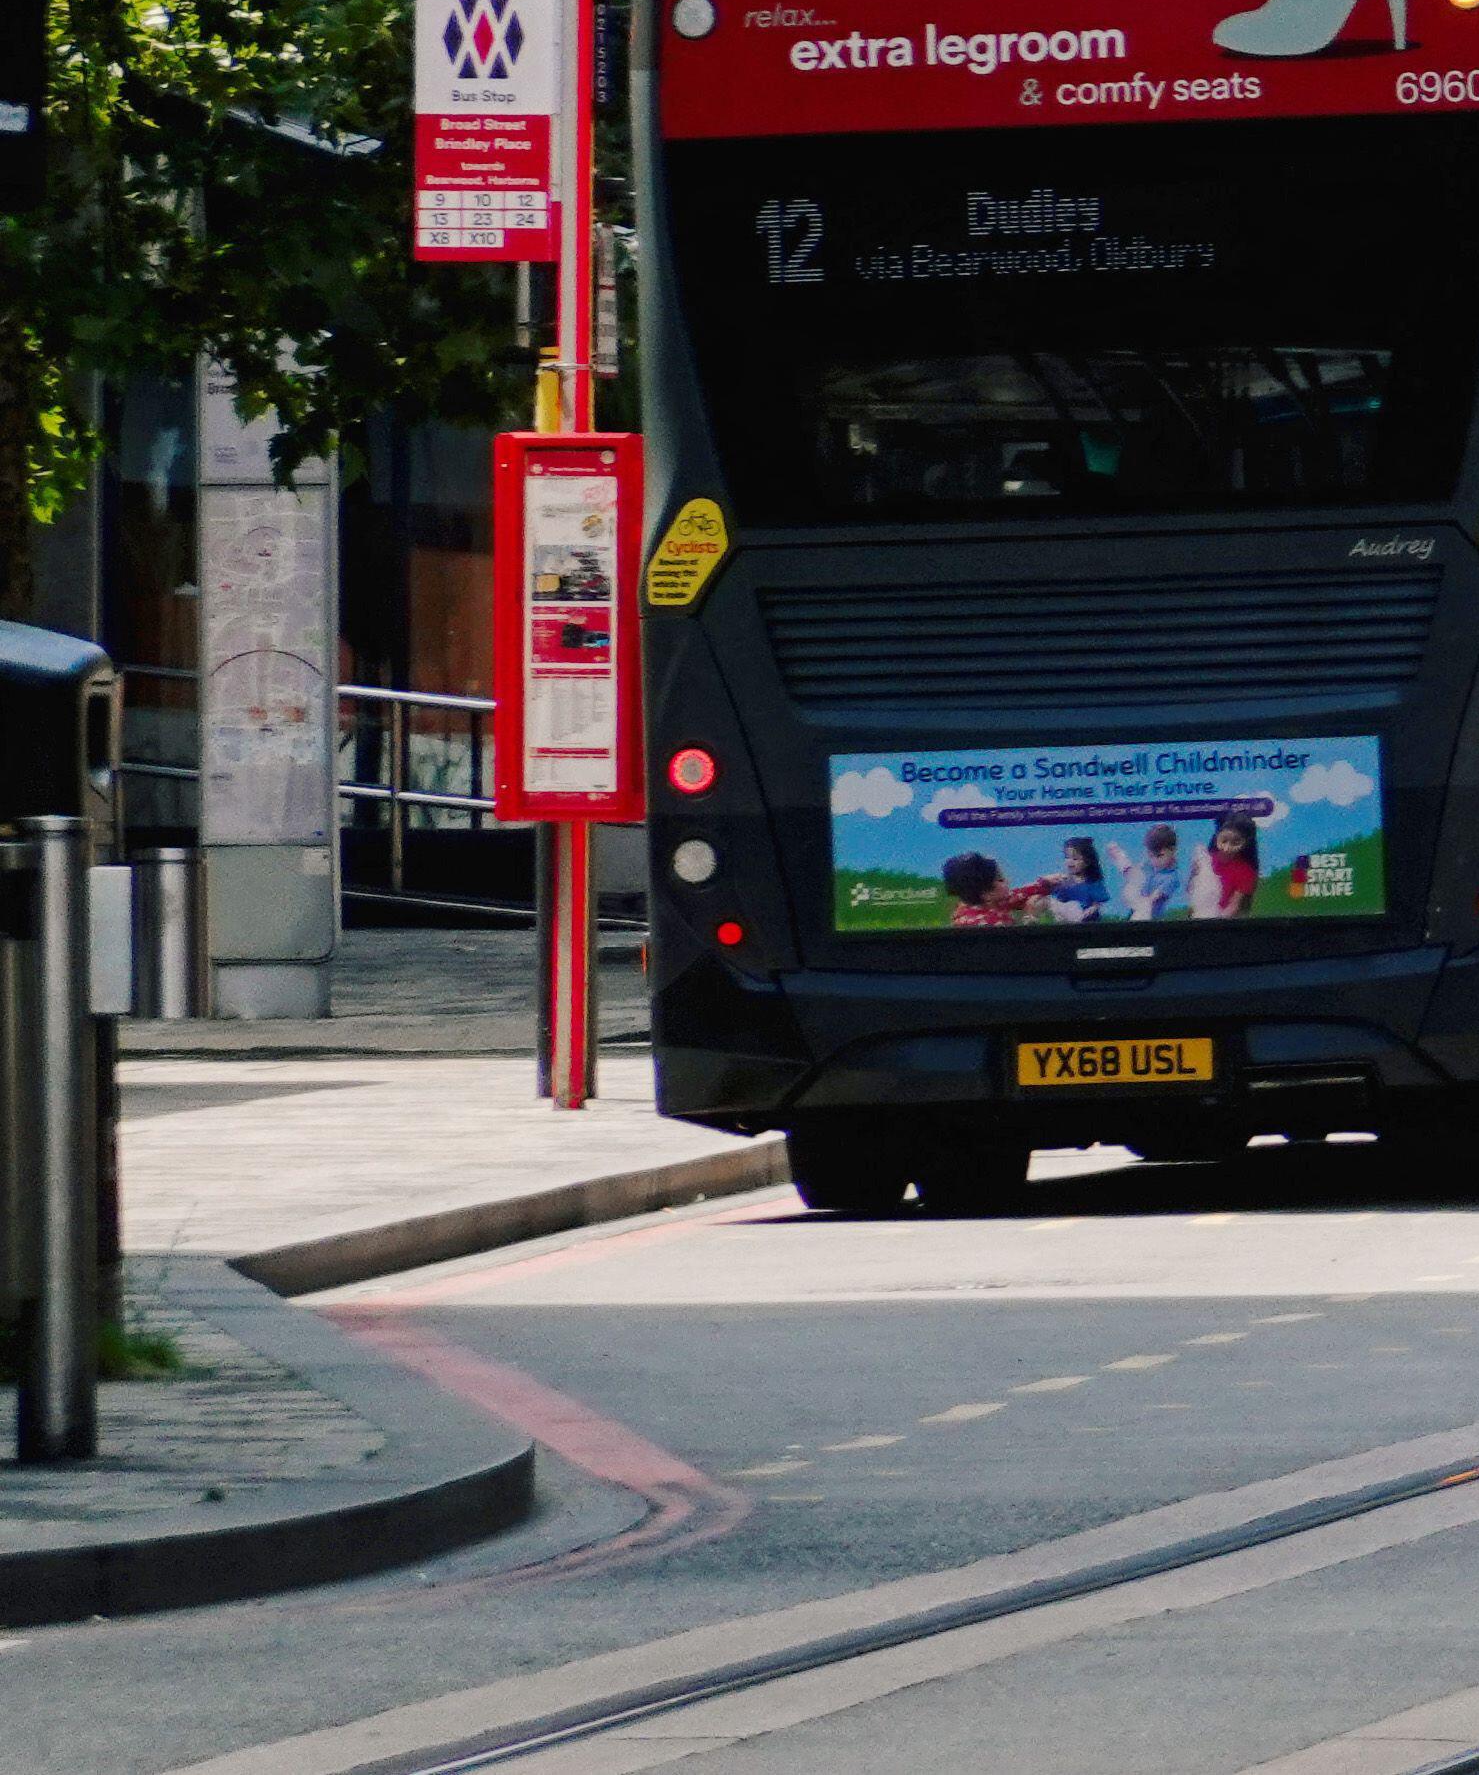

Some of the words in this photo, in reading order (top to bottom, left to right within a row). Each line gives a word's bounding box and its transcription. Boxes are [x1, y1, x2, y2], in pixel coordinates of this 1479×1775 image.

[744, 2, 837, 28] relax...
[789, 30, 913, 71] extra
[924, 24, 1127, 76] legroom
[451, 90, 478, 103] Bus
[482, 89, 517, 105] Stop
[1019, 77, 1043, 106] &
[1055, 71, 1166, 110] comfy
[1173, 71, 1263, 102] seats
[483, 118, 527, 131] Street
[436, 193, 446, 207] 9
[474, 193, 492, 207] 10
[517, 194, 535, 207] 12
[967, 189, 1099, 236] Dudley
[473, 212, 492, 226] 23
[515, 212, 536, 227] 24
[755, 197, 825, 284] 12
[855, 244, 904, 280] via
[1089, 236, 1217, 273] Oldbury
[665, 539, 721, 557] Cyclists
[1348, 534, 1436, 561] Audrey
[901, 761, 1004, 784] Become
[1012, 767, 1028, 780] a
[1034, 752, 1150, 779] Sandwell
[1155, 747, 1311, 776] Childminder
[993, 786, 1036, 802] Your
[1103, 780, 1148, 798] Their
[1309, 853, 1347, 868] BEST
[1032, 1044, 1120, 1079] YX68
[1130, 1043, 1197, 1077] USL
